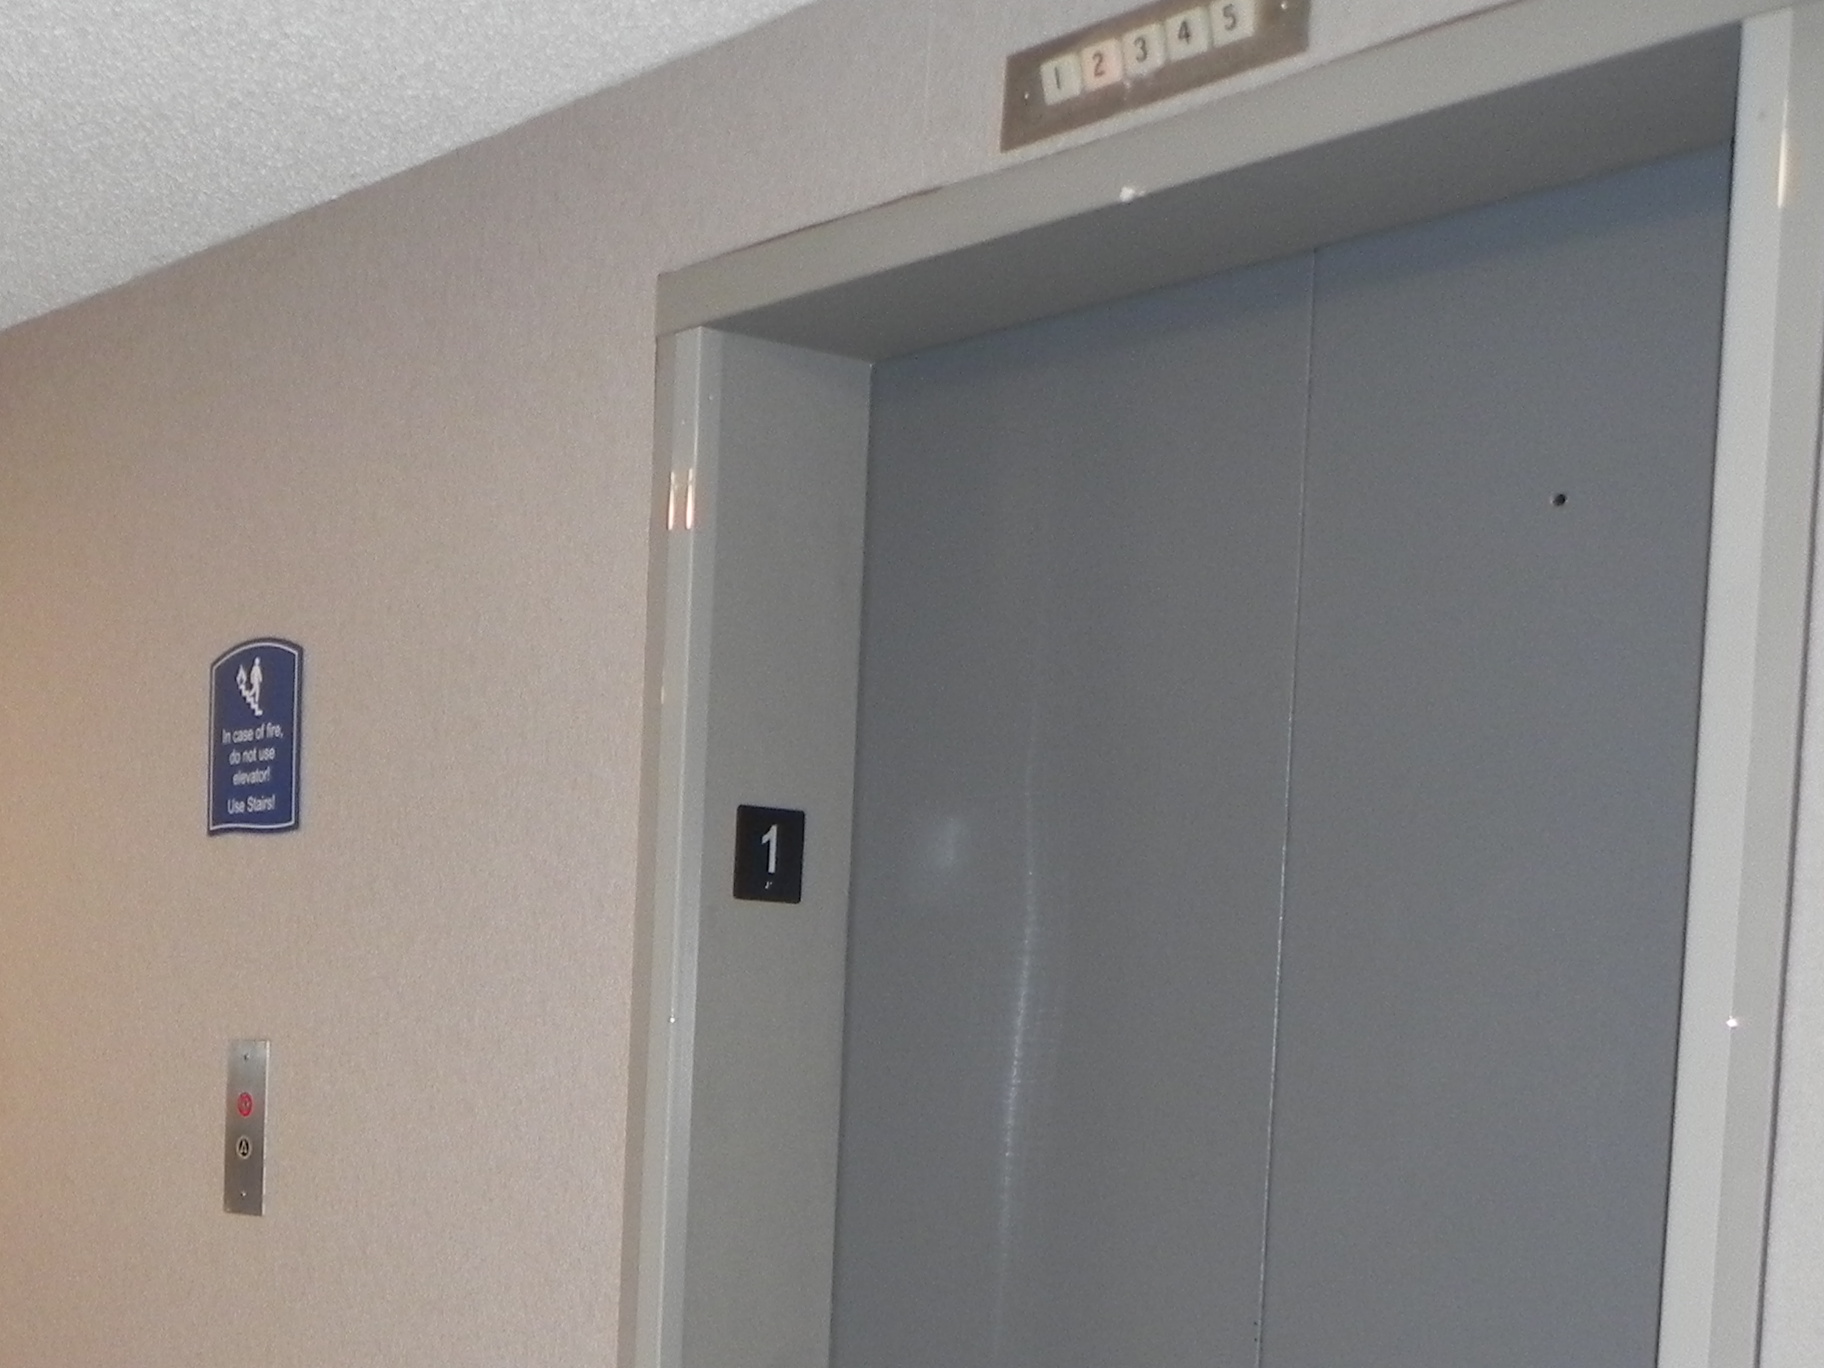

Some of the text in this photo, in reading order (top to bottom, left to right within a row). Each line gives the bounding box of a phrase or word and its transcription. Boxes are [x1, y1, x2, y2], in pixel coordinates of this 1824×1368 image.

[1053, 3, 1238, 90] 1 2 3 4 5
[222, 722, 284, 744] In case of fire,
[228, 747, 276, 766] do not use
[232, 766, 271, 786] elevator!
[227, 794, 276, 815] Use Stairs!
[761, 823, 778, 874] 1
